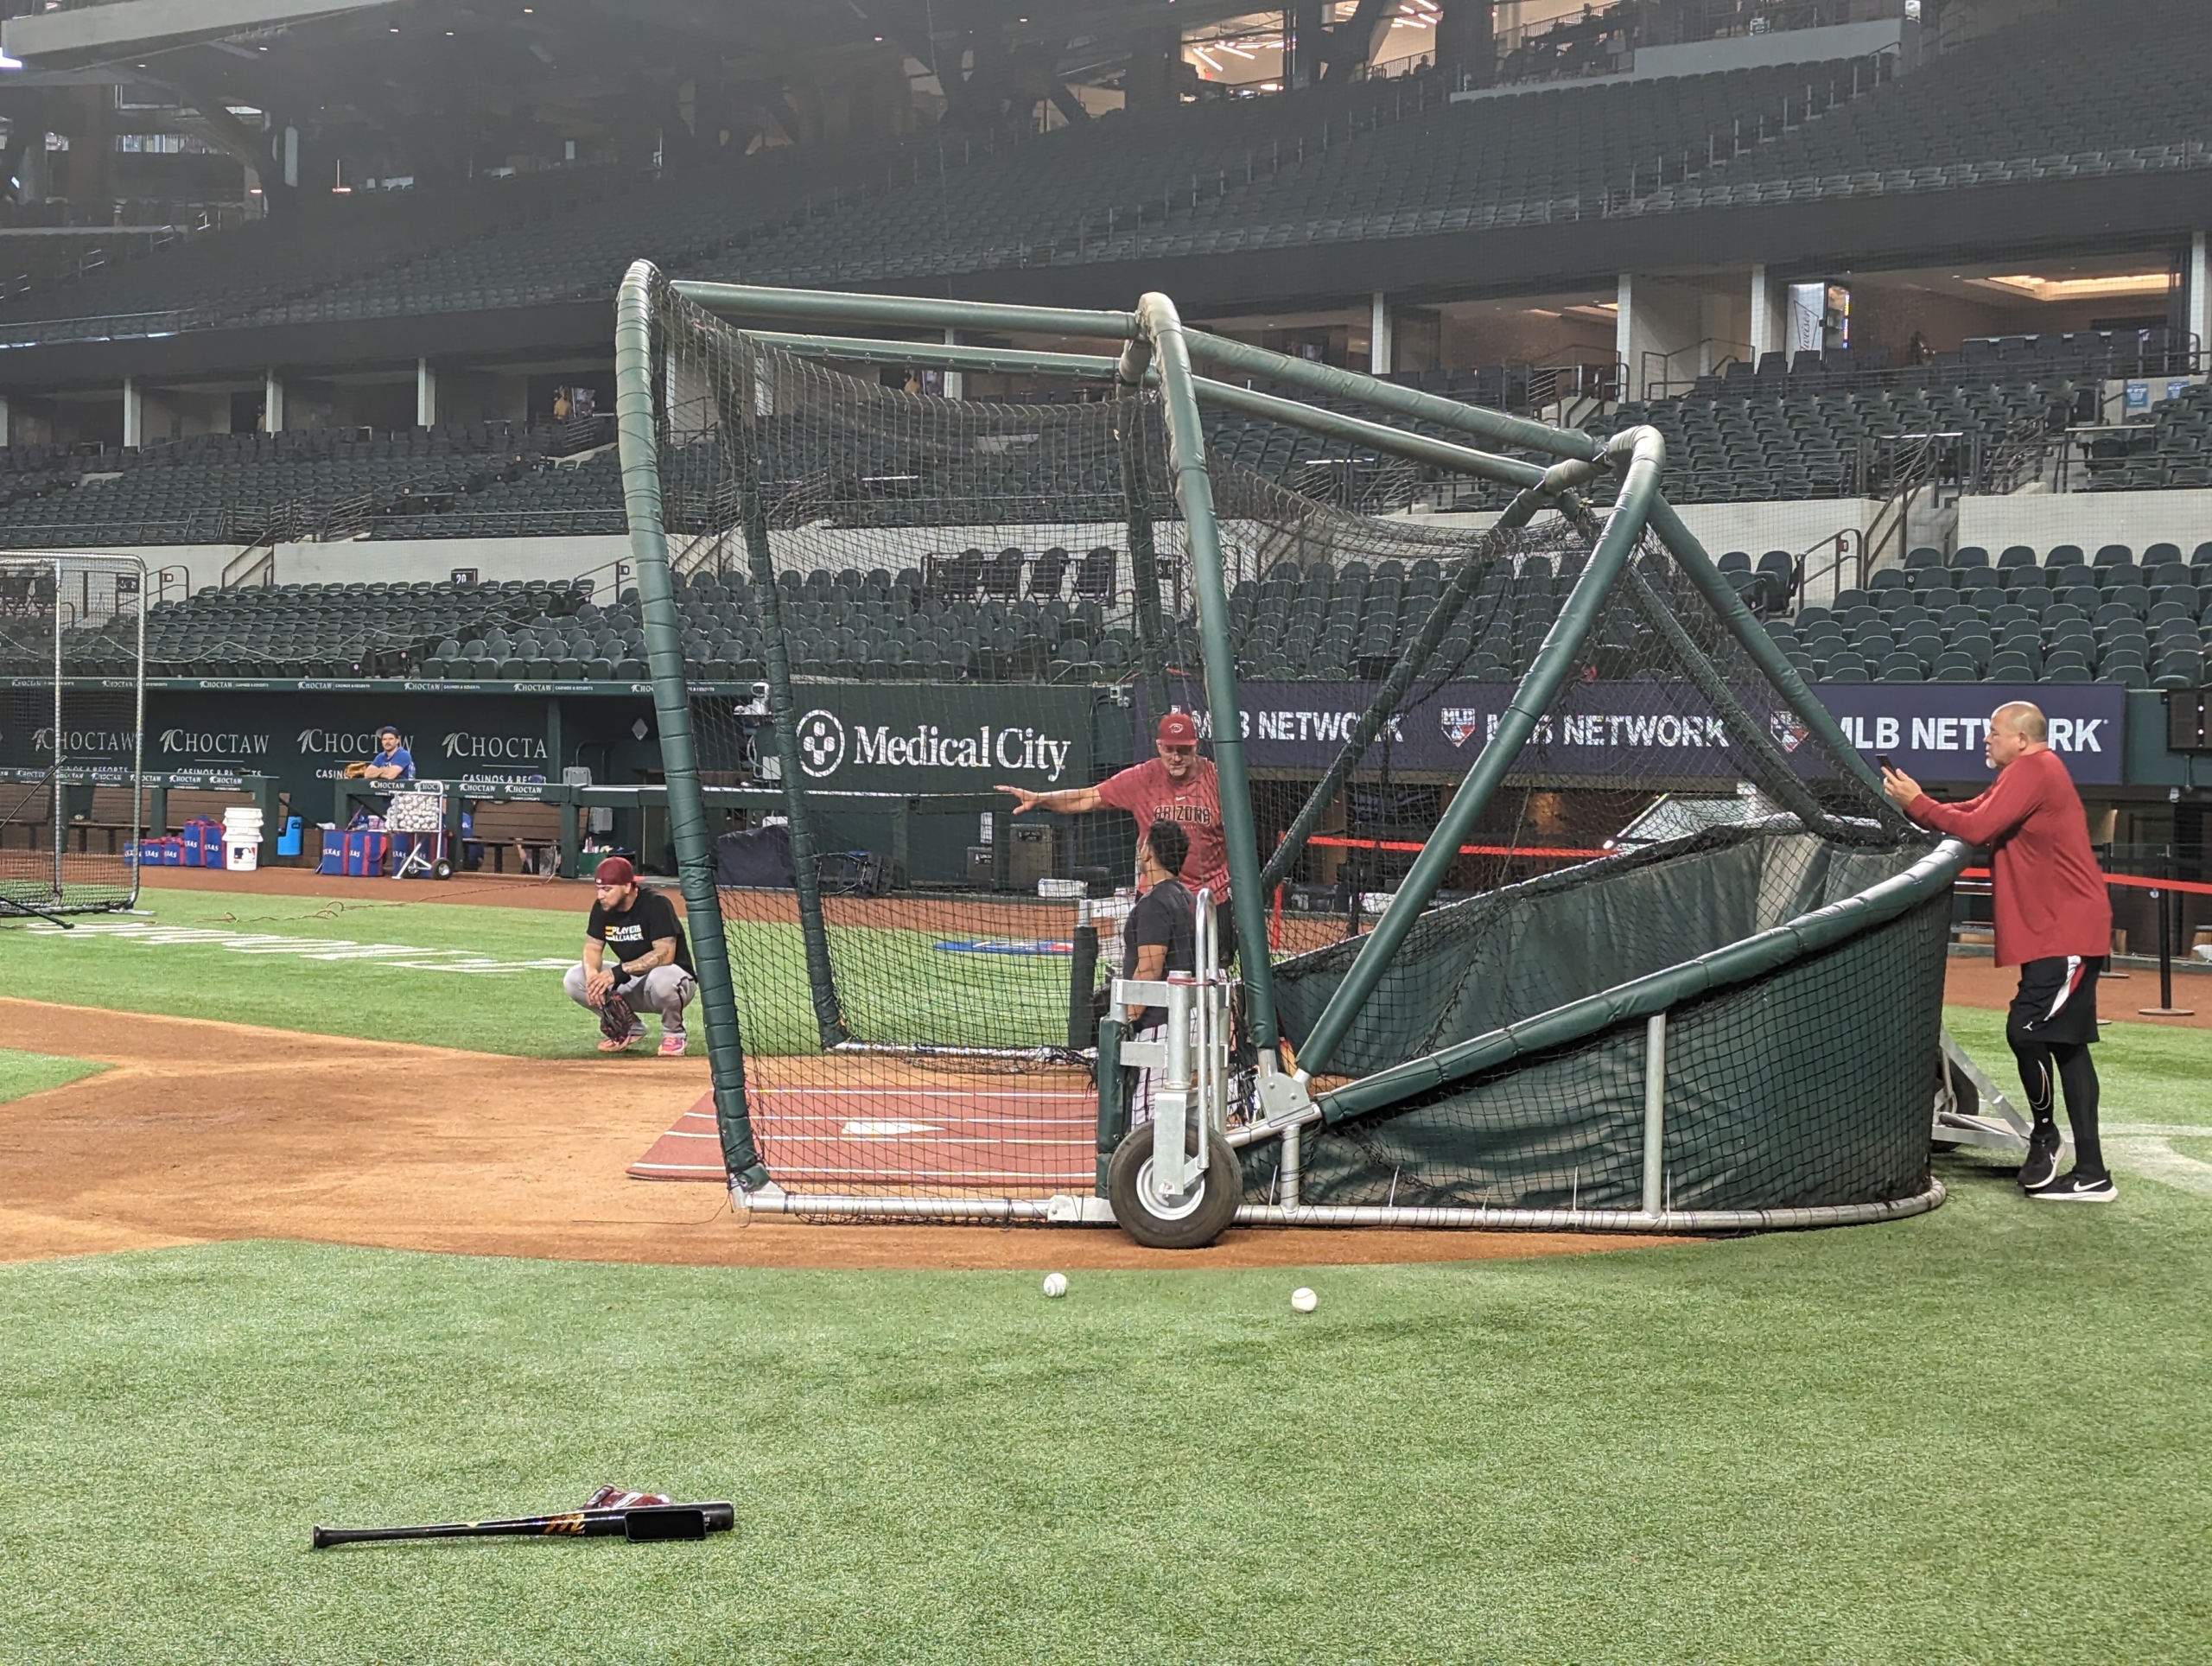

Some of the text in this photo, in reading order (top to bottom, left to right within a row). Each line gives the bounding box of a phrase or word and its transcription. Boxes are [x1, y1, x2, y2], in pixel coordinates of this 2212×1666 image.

[202, 680, 233, 689] CHOCTAW
[301, 681, 333, 690] CHOCTAW
[407, 682, 440, 690] CHOCTAW
[518, 683, 552, 691] CHOCTAW
[1258, 711, 1404, 742] NETWOK
[1564, 715, 1729, 747] NETWORK
[1911, 717, 2102, 752] NETRK
[170, 728, 270, 754] CHOCTAW
[308, 728, 414, 754] CHOCTW
[454, 732, 549, 758] CHOCTA
[853, 725, 1071, 781] Medical City
[172, 774, 202, 783] CHOCTAW
[212, 776, 243, 785] CHOCTAW
[373, 780, 406, 789] CHOCTAW
[462, 783, 496, 792] CHOCTAW
[508, 785, 543, 794] CHOCTAW
[1154, 805, 1212, 826] ARIZONA
[613, 925, 642, 935] PLAYERS
[613, 932, 645, 943] ALLIANCE
